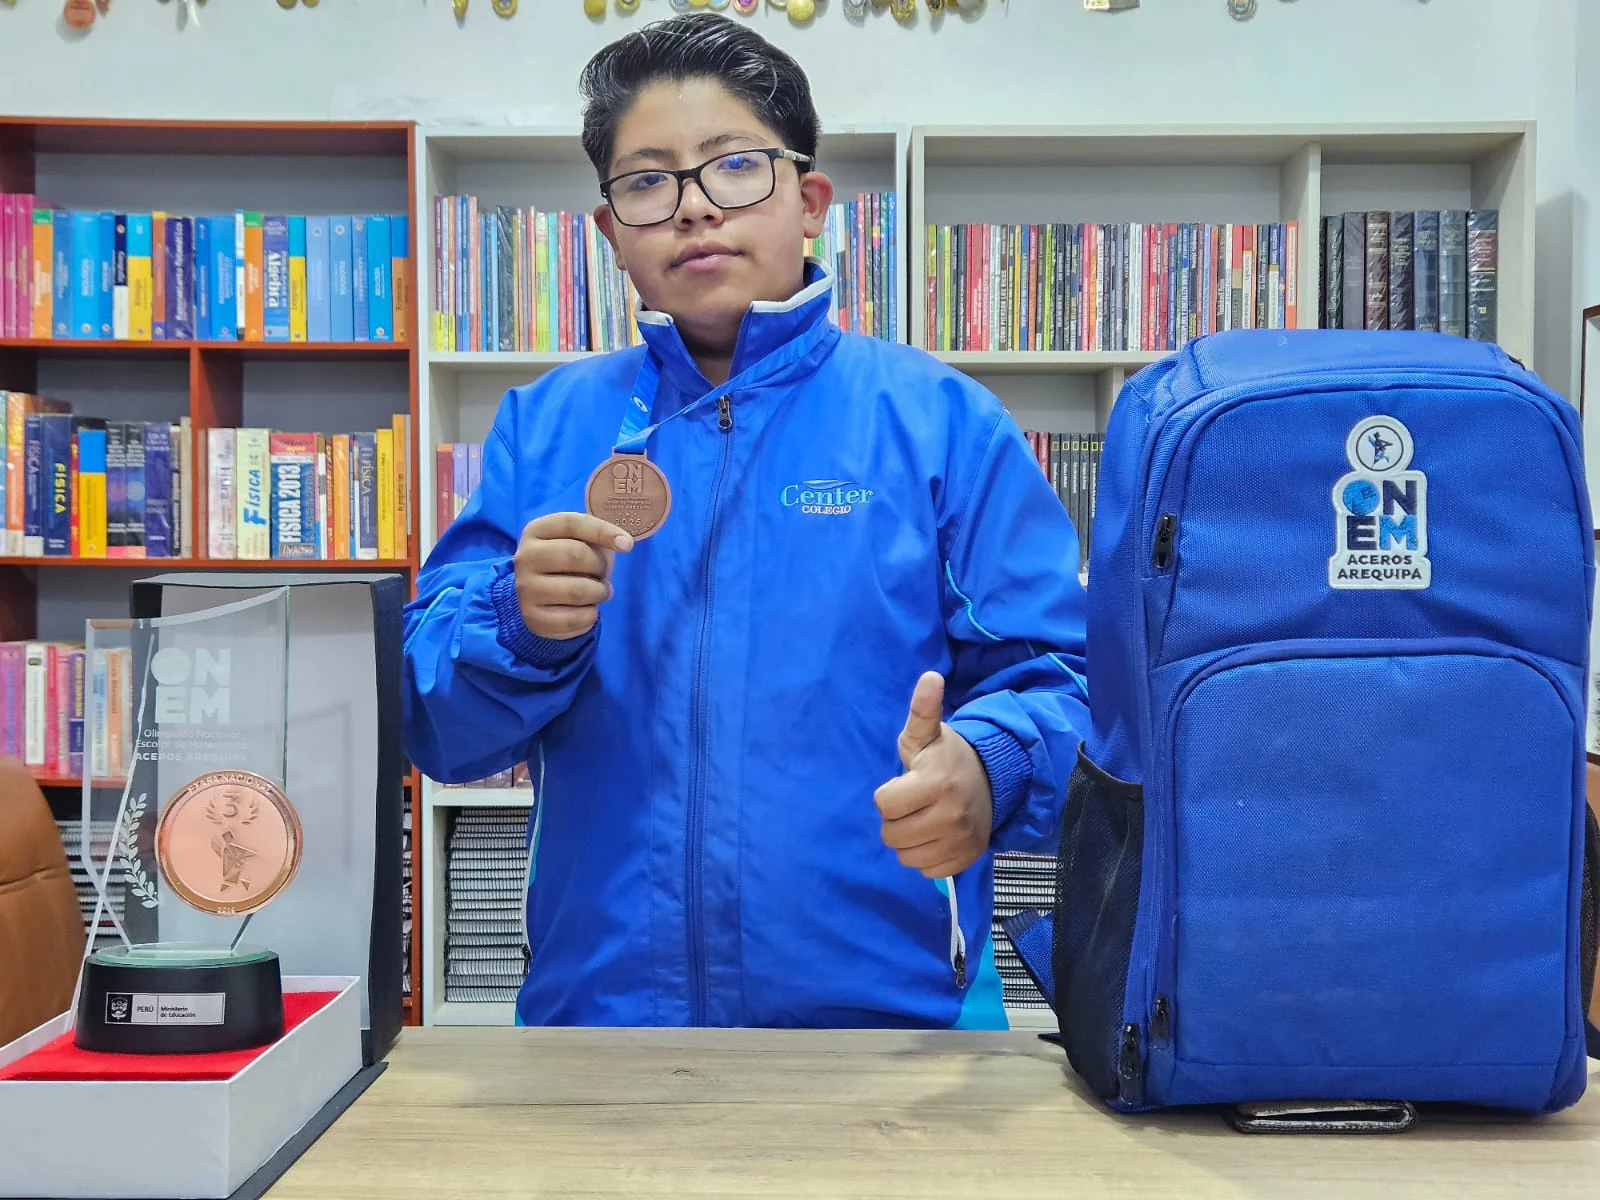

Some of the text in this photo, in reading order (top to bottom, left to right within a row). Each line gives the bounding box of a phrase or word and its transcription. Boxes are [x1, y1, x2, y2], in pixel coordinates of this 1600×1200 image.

[780, 484, 874, 507] Center
[801, 505, 852, 515] COLEGIO
[1347, 554, 1413, 566] ACEROS
[1337, 568, 1423, 581] AREQUIPA
[136, 752, 183, 761] ACEROS
[223, 792, 240, 818] 3
[136, 1004, 154, 1013] PERÚ
